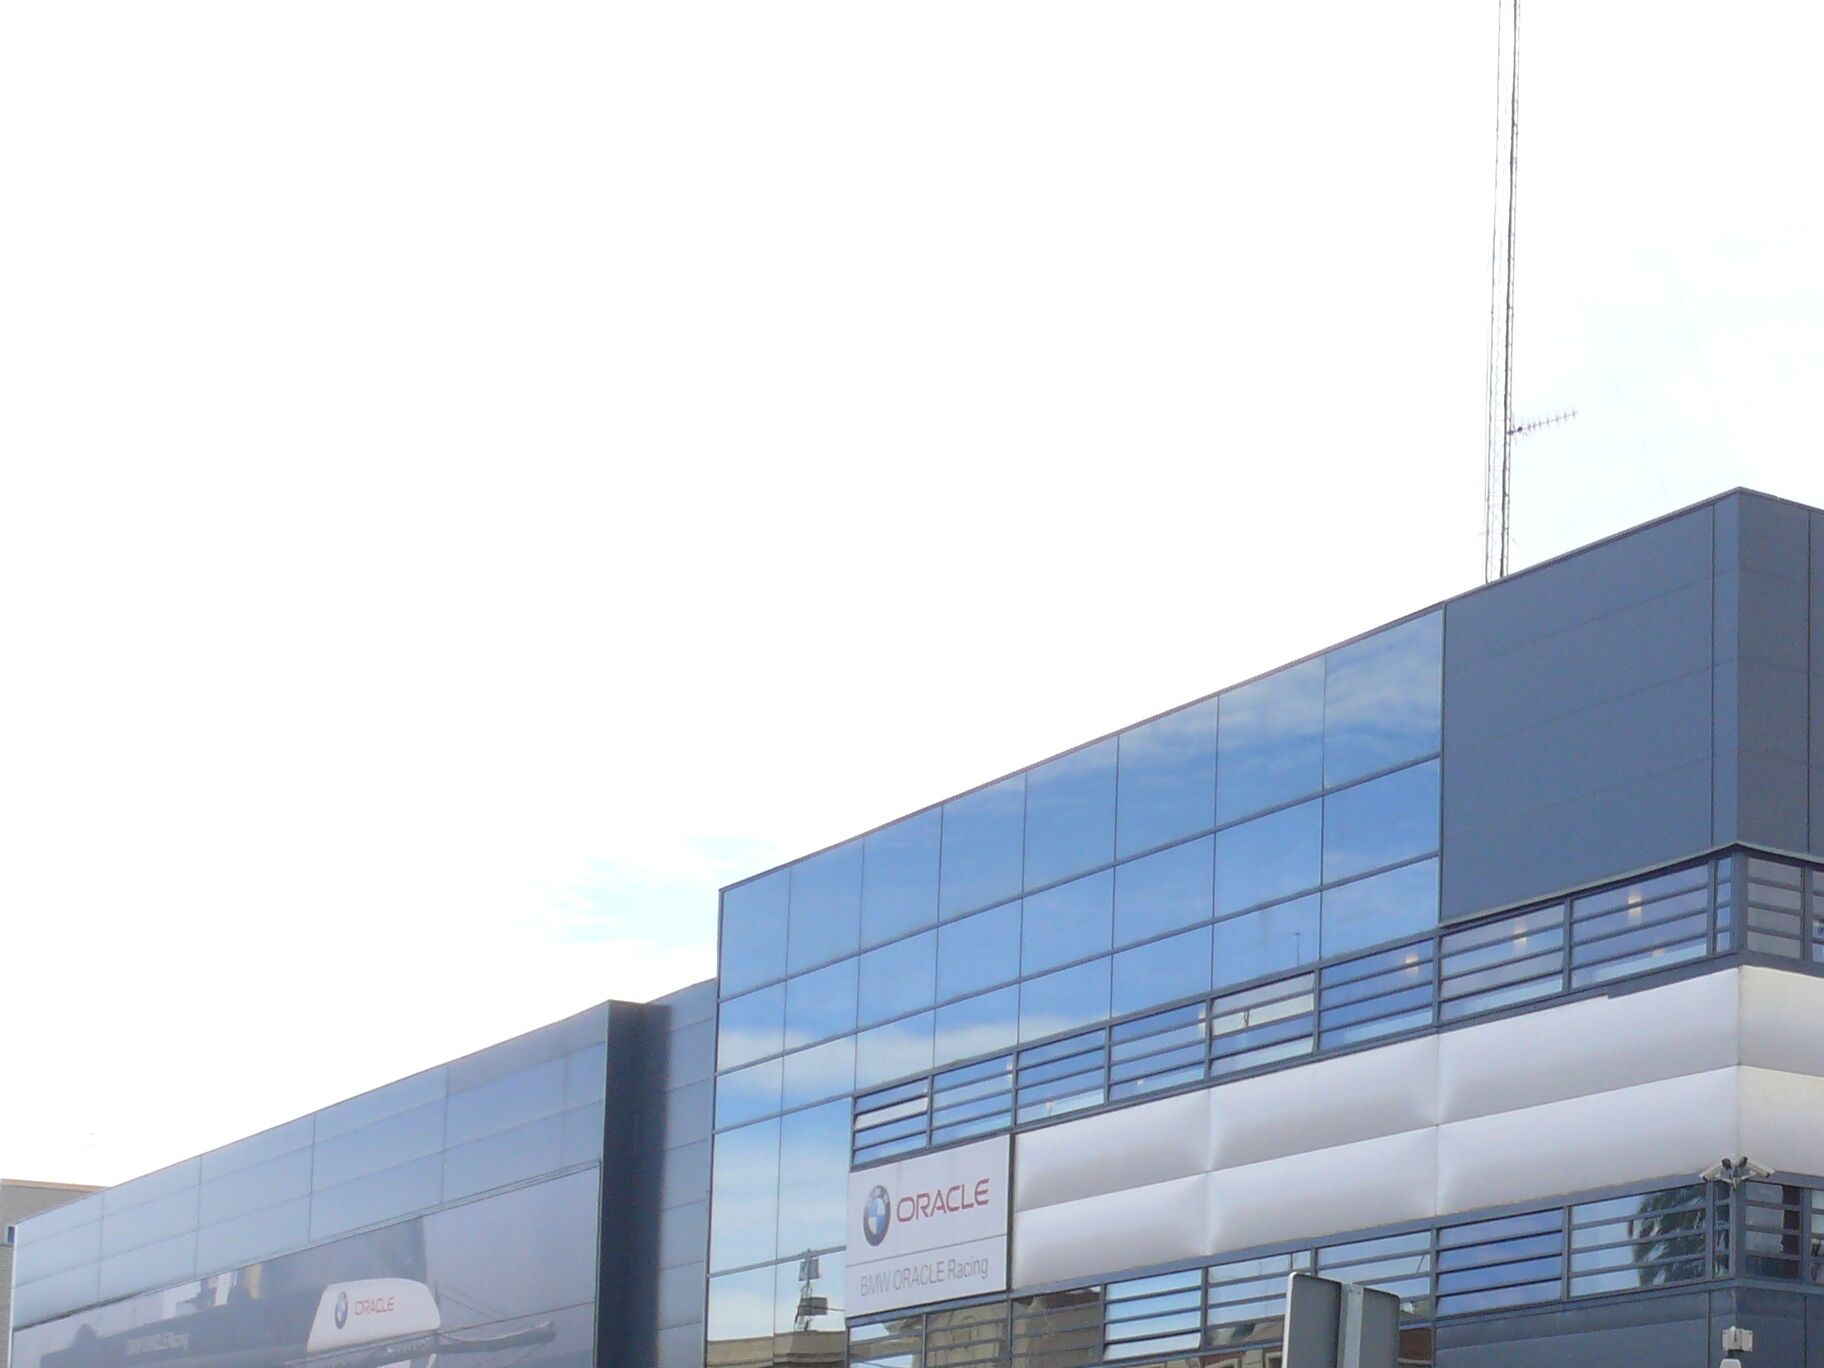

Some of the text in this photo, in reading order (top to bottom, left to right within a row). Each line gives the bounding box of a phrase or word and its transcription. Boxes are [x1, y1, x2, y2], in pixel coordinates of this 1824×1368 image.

[897, 1178, 990, 1223] ORACLE
[860, 1256, 989, 1297] BMW ORACLE Racing
[354, 1297, 395, 1316] ORACLE
